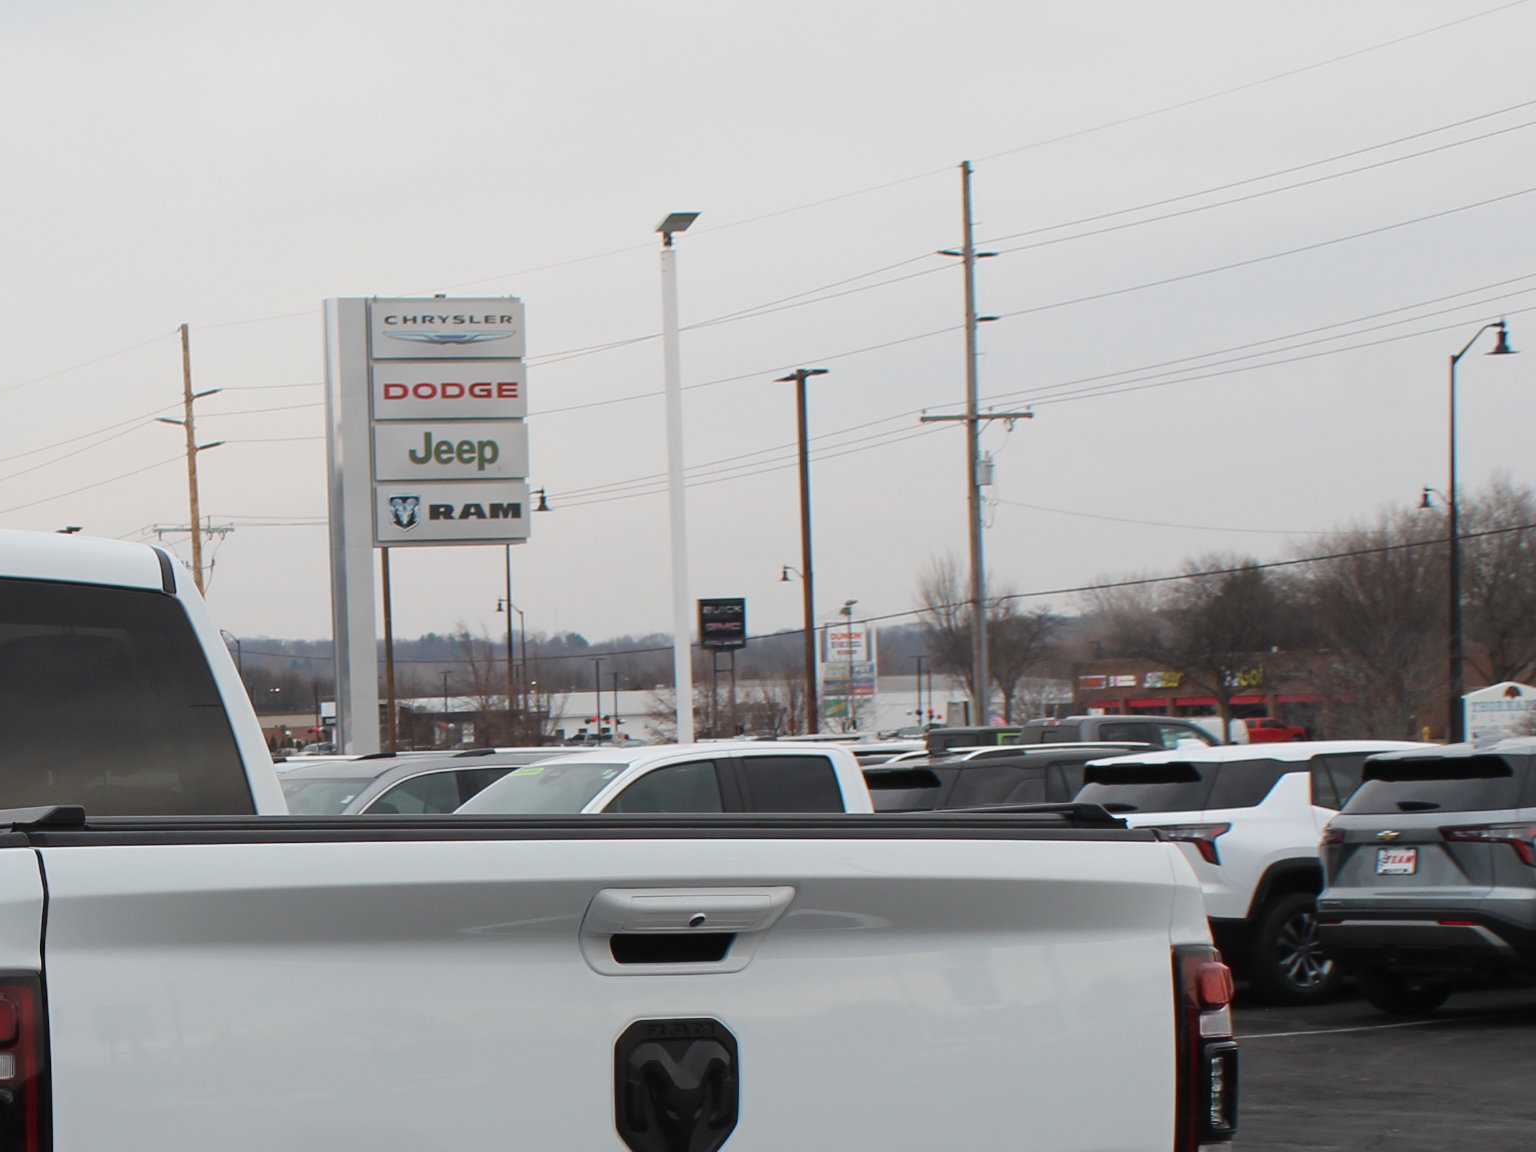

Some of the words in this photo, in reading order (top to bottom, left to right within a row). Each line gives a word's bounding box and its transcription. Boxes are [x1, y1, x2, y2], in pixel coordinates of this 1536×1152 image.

[384, 314, 513, 325] CHRYSLER
[383, 382, 519, 400] DODGE
[409, 431, 500, 471] Jeep
[428, 502, 522, 521] RAM
